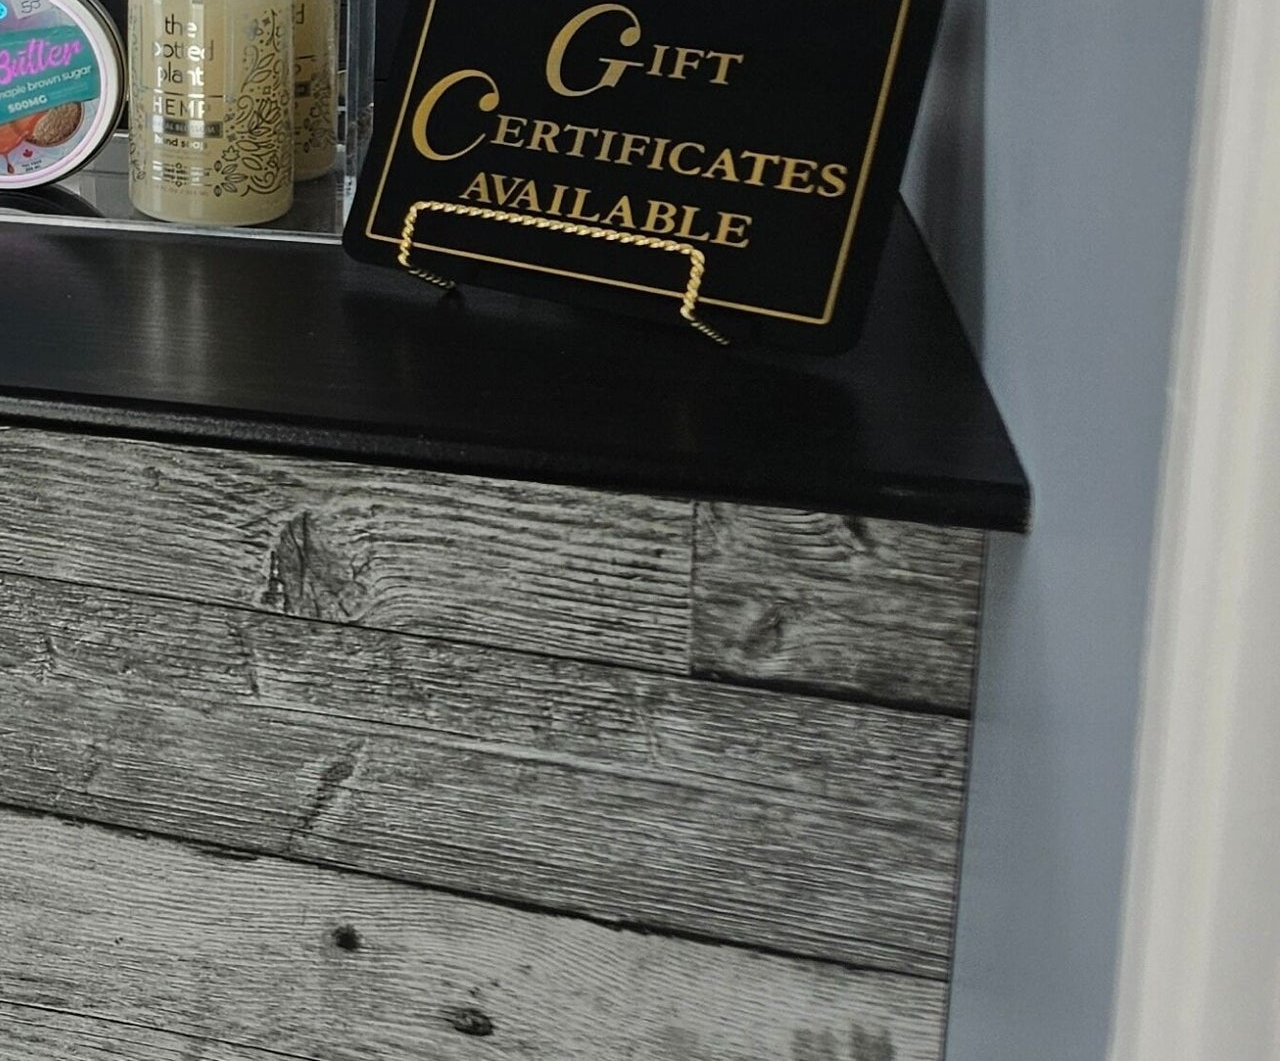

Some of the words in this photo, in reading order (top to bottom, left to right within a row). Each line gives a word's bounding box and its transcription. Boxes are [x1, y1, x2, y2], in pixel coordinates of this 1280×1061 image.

[165, 13, 198, 38] the
[545, 3, 744, 98] GIFT
[27, 75, 62, 91] brown
[62, 65, 92, 82] sugar
[158, 61, 204, 88] plant
[7, 94, 48, 114] 500MG
[153, 96, 210, 119] HEMP
[411, 68, 848, 199] CERTIFICATES
[458, 172, 754, 249] AVAILABLE
